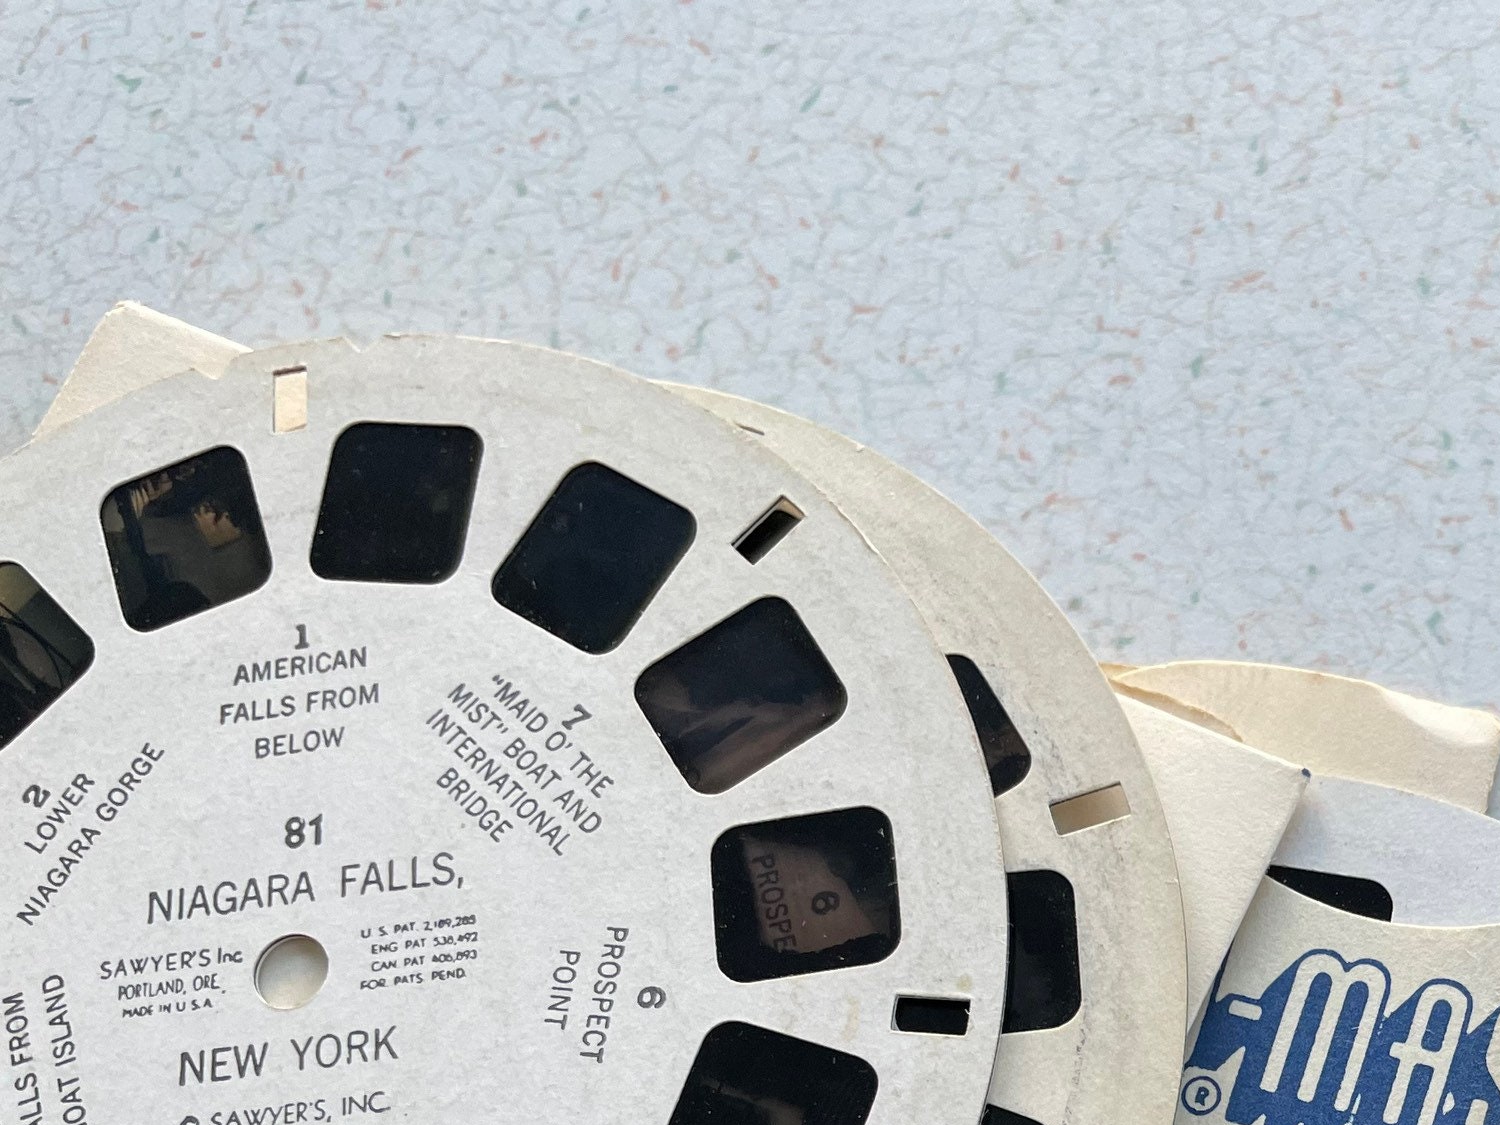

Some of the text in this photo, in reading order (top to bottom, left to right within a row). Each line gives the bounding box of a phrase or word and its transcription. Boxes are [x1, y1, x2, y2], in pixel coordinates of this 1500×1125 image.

[293, 623, 311, 650] 1
[233, 646, 368, 686] AMERICAN
[219, 683, 380, 725] FALLS FROM
[561, 703, 593, 731] 7
[254, 726, 346, 759] BELOW
[492, 674, 549, 733] "MAID
[569, 750, 615, 799] THE
[447, 682, 603, 834] MIST" BOAT AND
[21, 784, 51, 809] 2
[425, 708, 571, 857] INTERNATIONAL
[24, 773, 96, 855] LOWER
[436, 767, 514, 844] BRIDGE
[16, 742, 165, 926] NIAGARA GORGE
[284, 813, 324, 849] 81
[147, 852, 464, 924] NIAGARA FALLS,
[100, 948, 212, 980] SAWYER'S
[371, 942, 399, 955] ENG
[405, 938, 426, 950] PAT
[371, 960, 397, 972] CAN
[404, 955, 425, 967] PAT
[360, 978, 389, 990] FOR
[394, 972, 424, 986] PATS
[544, 950, 581, 1031] POINT
[580, 926, 629, 1064] PROSPECT
[637, 985, 667, 1009] 6
[2, 992, 34, 1067] FROM
[42, 974, 77, 1067] ISLAND
[122, 1005, 153, 1018] MADE
[179, 1025, 399, 1086] NEW YORK
